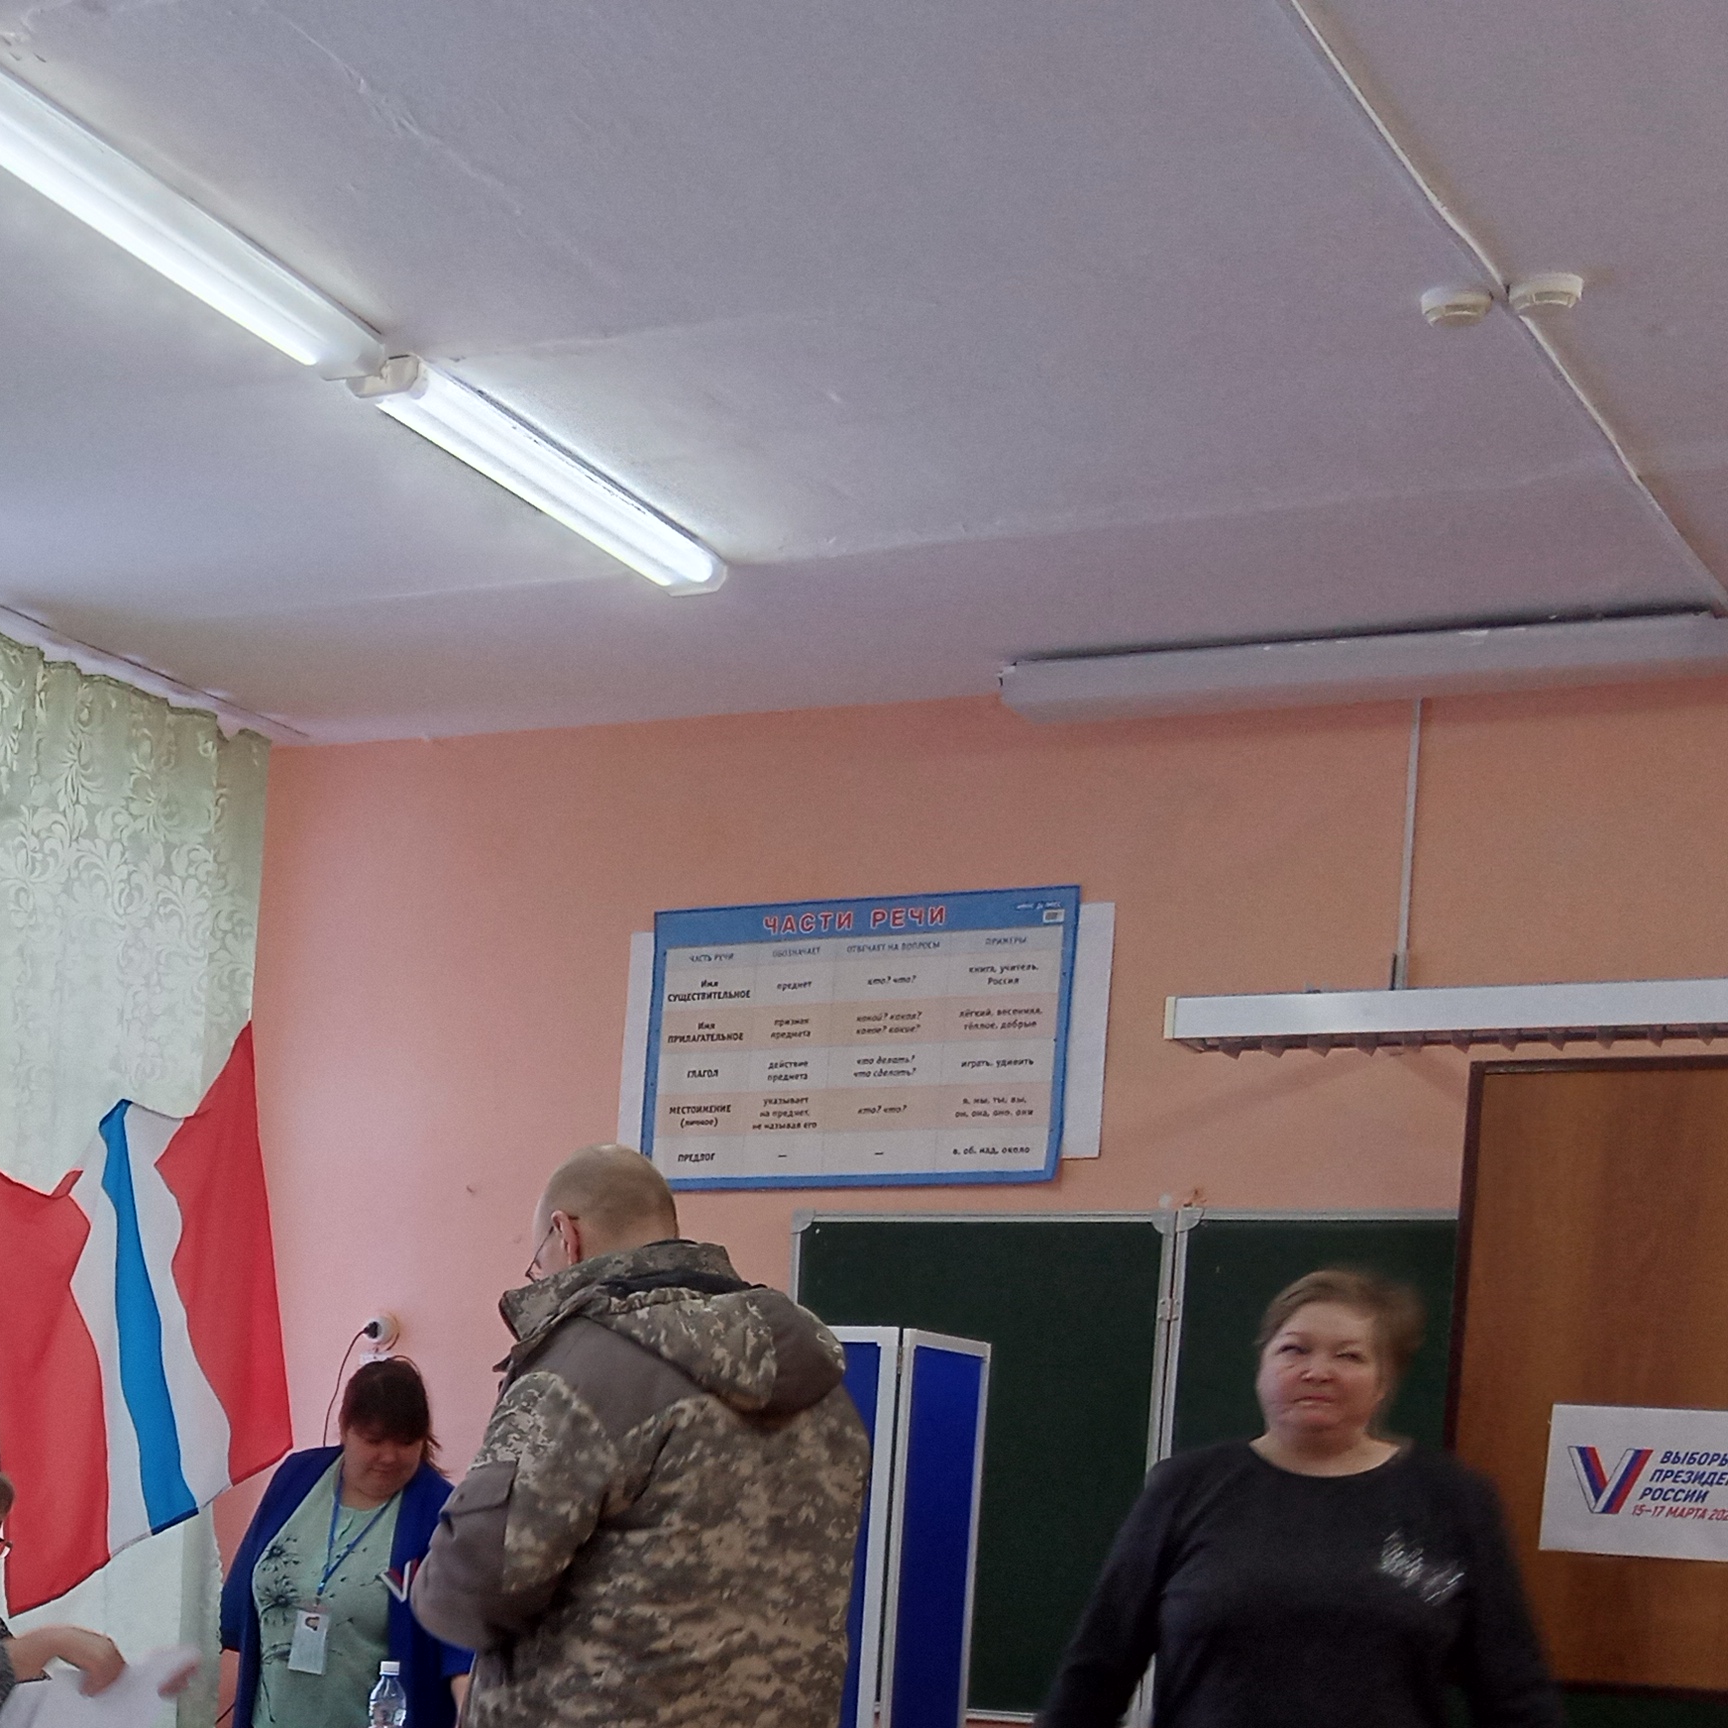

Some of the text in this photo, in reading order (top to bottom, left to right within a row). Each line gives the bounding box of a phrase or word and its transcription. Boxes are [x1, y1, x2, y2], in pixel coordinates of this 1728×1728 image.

[763, 905, 947, 935] ЧАСТИ РЕЧИ
[667, 990, 751, 1003] СУЩЕСТВИТЕЛЬНОЕ
[1649, 1468, 1728, 1487] ПРЕЗИДЕ
[1638, 1487, 1710, 1503] РОССИИ
[1665, 1506, 1708, 1520] МАРТА
